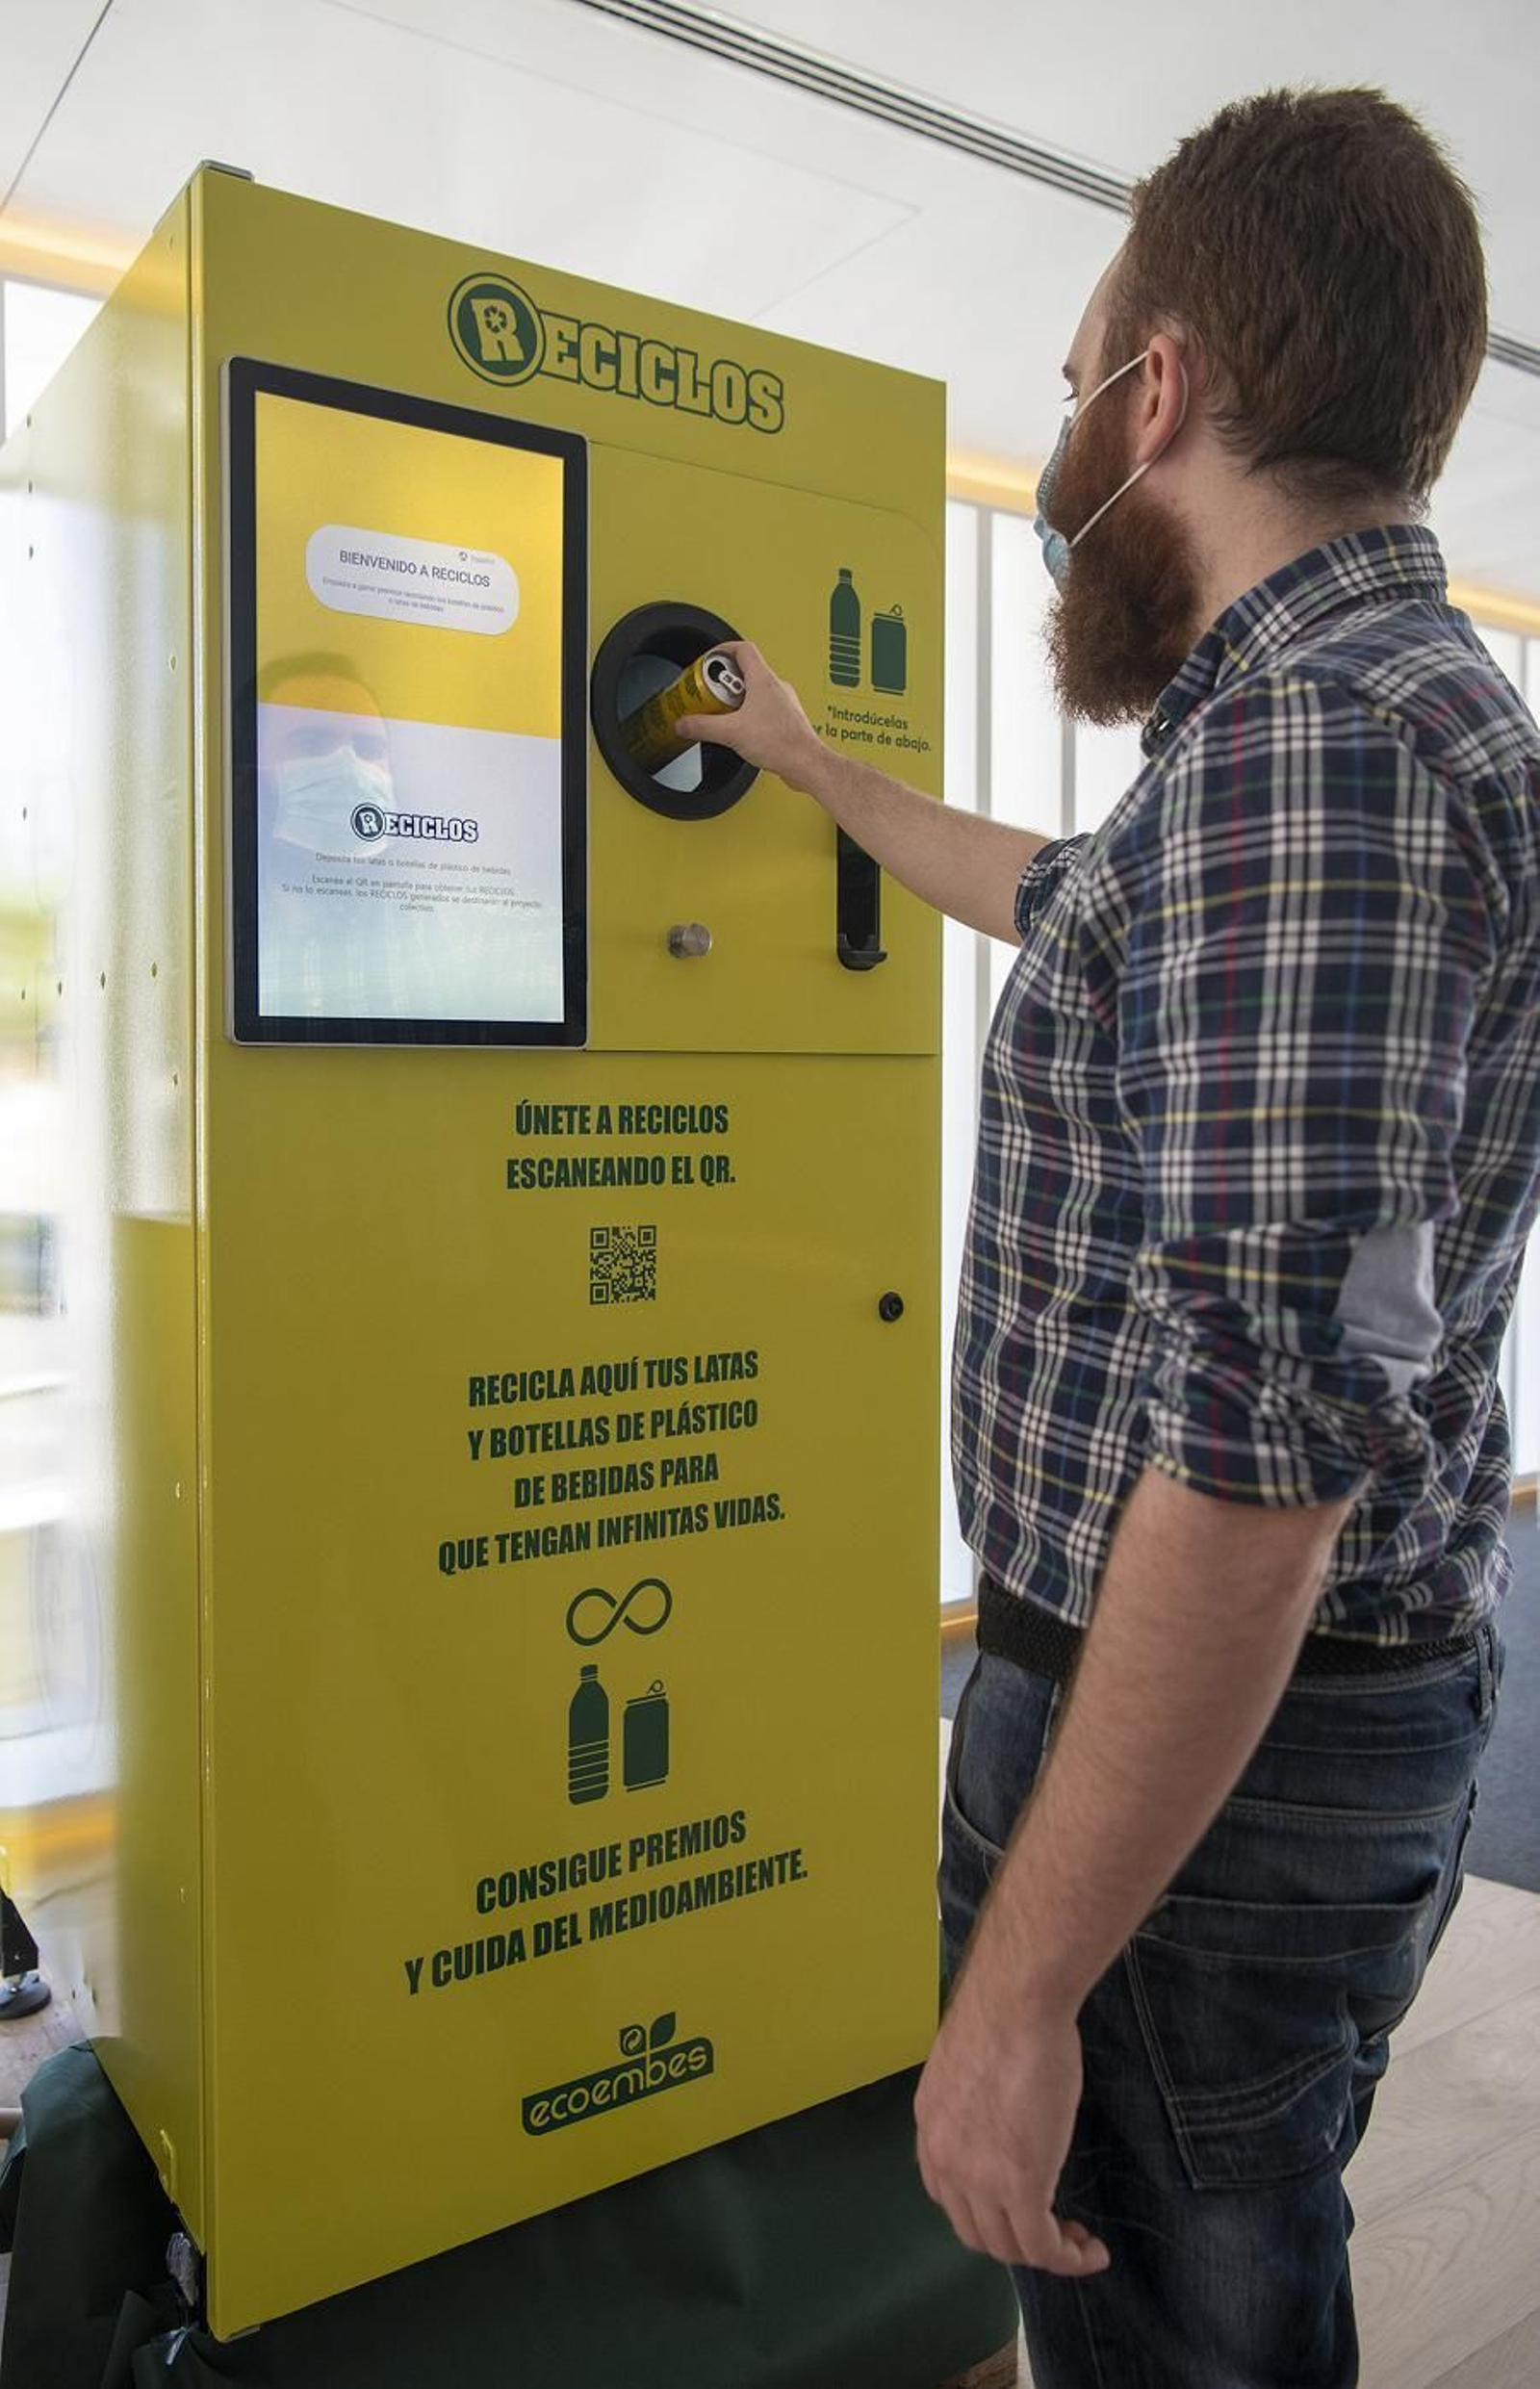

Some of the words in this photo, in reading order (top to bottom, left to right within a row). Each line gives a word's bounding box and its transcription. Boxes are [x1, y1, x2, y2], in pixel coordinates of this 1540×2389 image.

[448, 272, 784, 434] RECICLOS
[339, 550, 418, 576] BIENVENIDO
[420, 564, 429, 578] A
[431, 566, 491, 588] RECICLOS
[825, 723, 837, 737] la
[840, 728, 874, 743] parte
[877, 732, 892, 745] de
[895, 734, 932, 753] abajo.
[350, 802, 479, 843] RECICLOS
[515, 1099, 591, 1136] ÚNETE
[596, 1105, 612, 1135] A
[618, 1104, 729, 1135] RECICLOS
[506, 1157, 666, 1190] ESCANEANDO
[672, 1156, 694, 1185] EL
[700, 1155, 735, 1187] QR.
[469, 1368, 575, 1407] RECICLA
[580, 1356, 638, 1397] AQUÍ
[644, 1355, 688, 1389] TUS
[694, 1349, 758, 1383] LATAS
[468, 1429, 482, 1461] Y
[490, 1416, 609, 1459] BOTELLAS
[616, 1411, 644, 1443] DE
[651, 1399, 757, 1439] PLÁSTICO
[514, 1476, 544, 1508] DE
[552, 1461, 654, 1503] BEBIDAS
[660, 1452, 719, 1487] PARA
[439, 1536, 489, 1576] QUE
[495, 1521, 590, 1565] TENGAN
[598, 1503, 709, 1548] INFINITAS
[714, 1492, 784, 1528] VIDAS.
[475, 1842, 622, 1914] CONSIGUE
[628, 1810, 747, 1872] PREMIOS
[404, 1957, 424, 1996] Y
[431, 1928, 526, 1989] CUIDA
[533, 1913, 582, 1958] DEL
[589, 1848, 808, 1941] MEDIOAMBIENTE.
[529, 2042, 708, 2129] ecoembes
